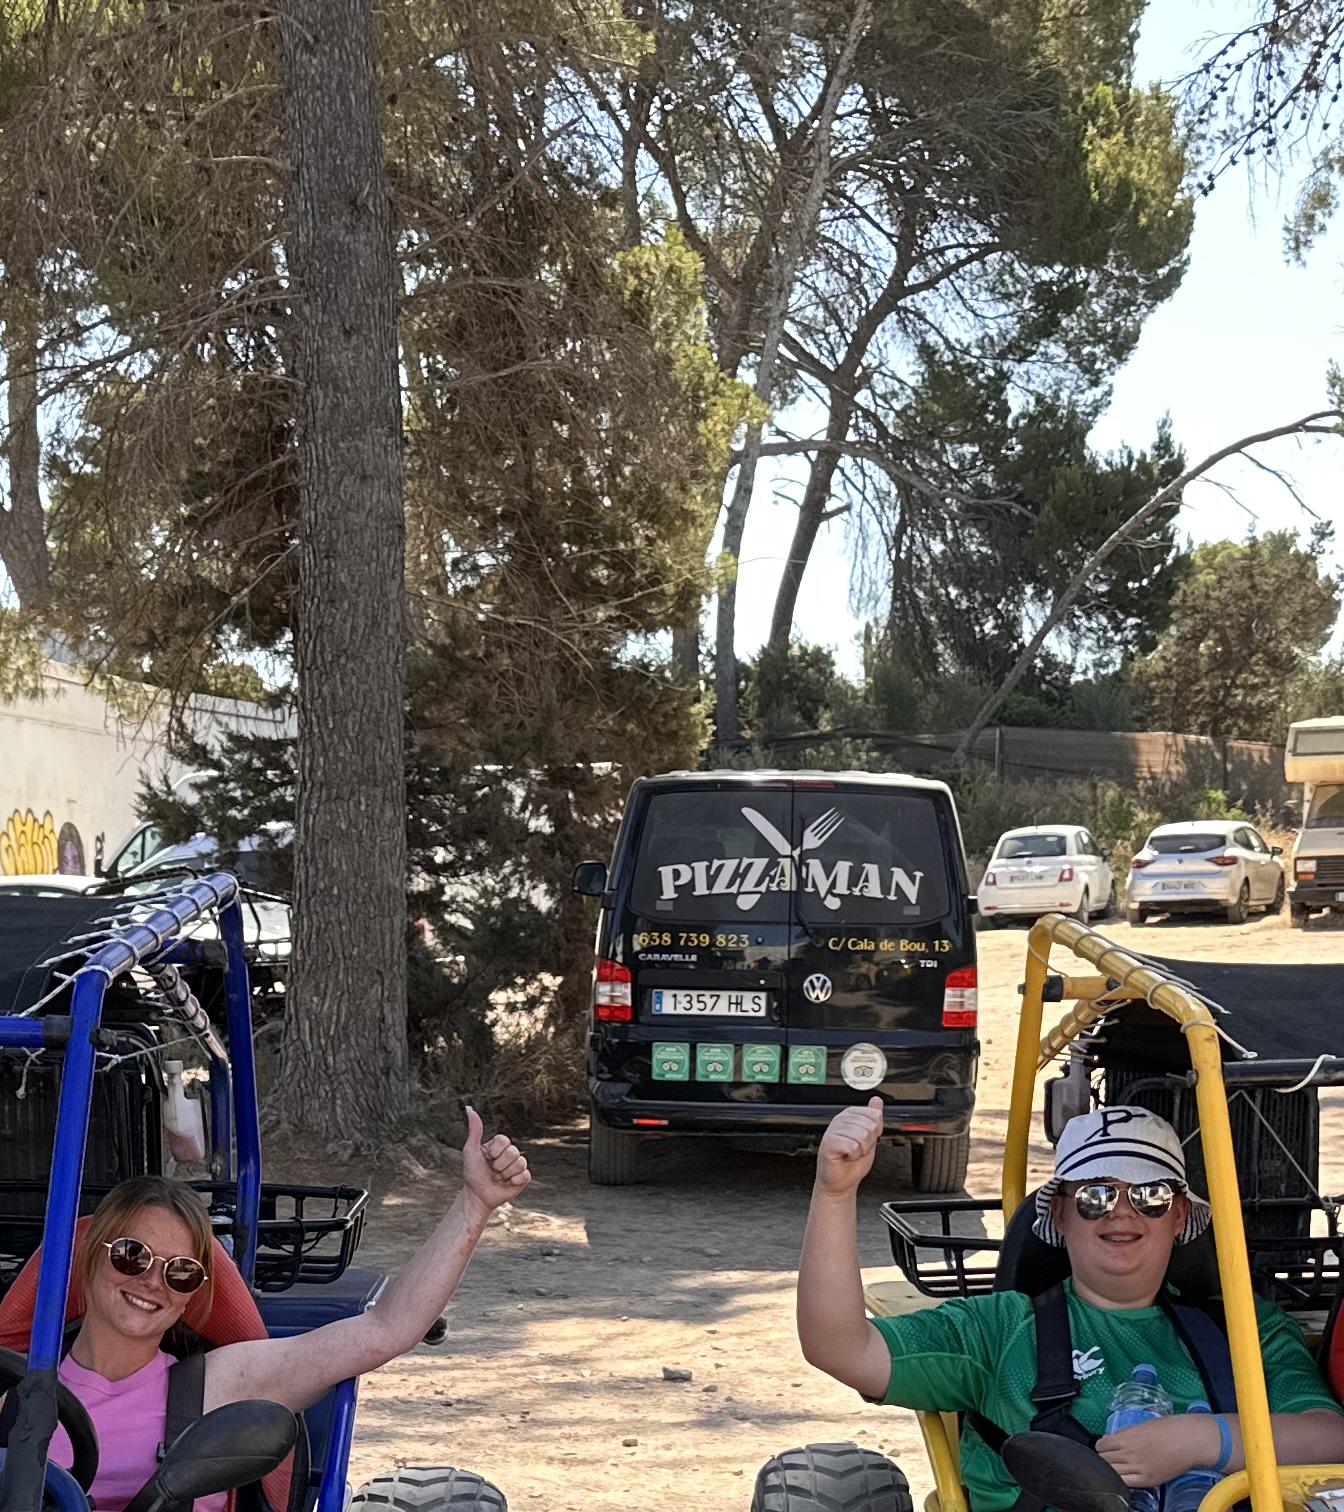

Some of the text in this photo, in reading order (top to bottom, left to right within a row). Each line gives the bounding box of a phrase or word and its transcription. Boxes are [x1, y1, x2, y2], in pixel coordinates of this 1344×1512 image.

[638, 932, 749, 948] 638 739 823
[879, 938, 895, 951] de
[899, 938, 929, 953] Bou,
[933, 939, 950, 952] 13
[638, 953, 698, 962] CARAVELLE
[919, 959, 938, 968] TDI
[672, 993, 762, 1013] 1357 HLS
